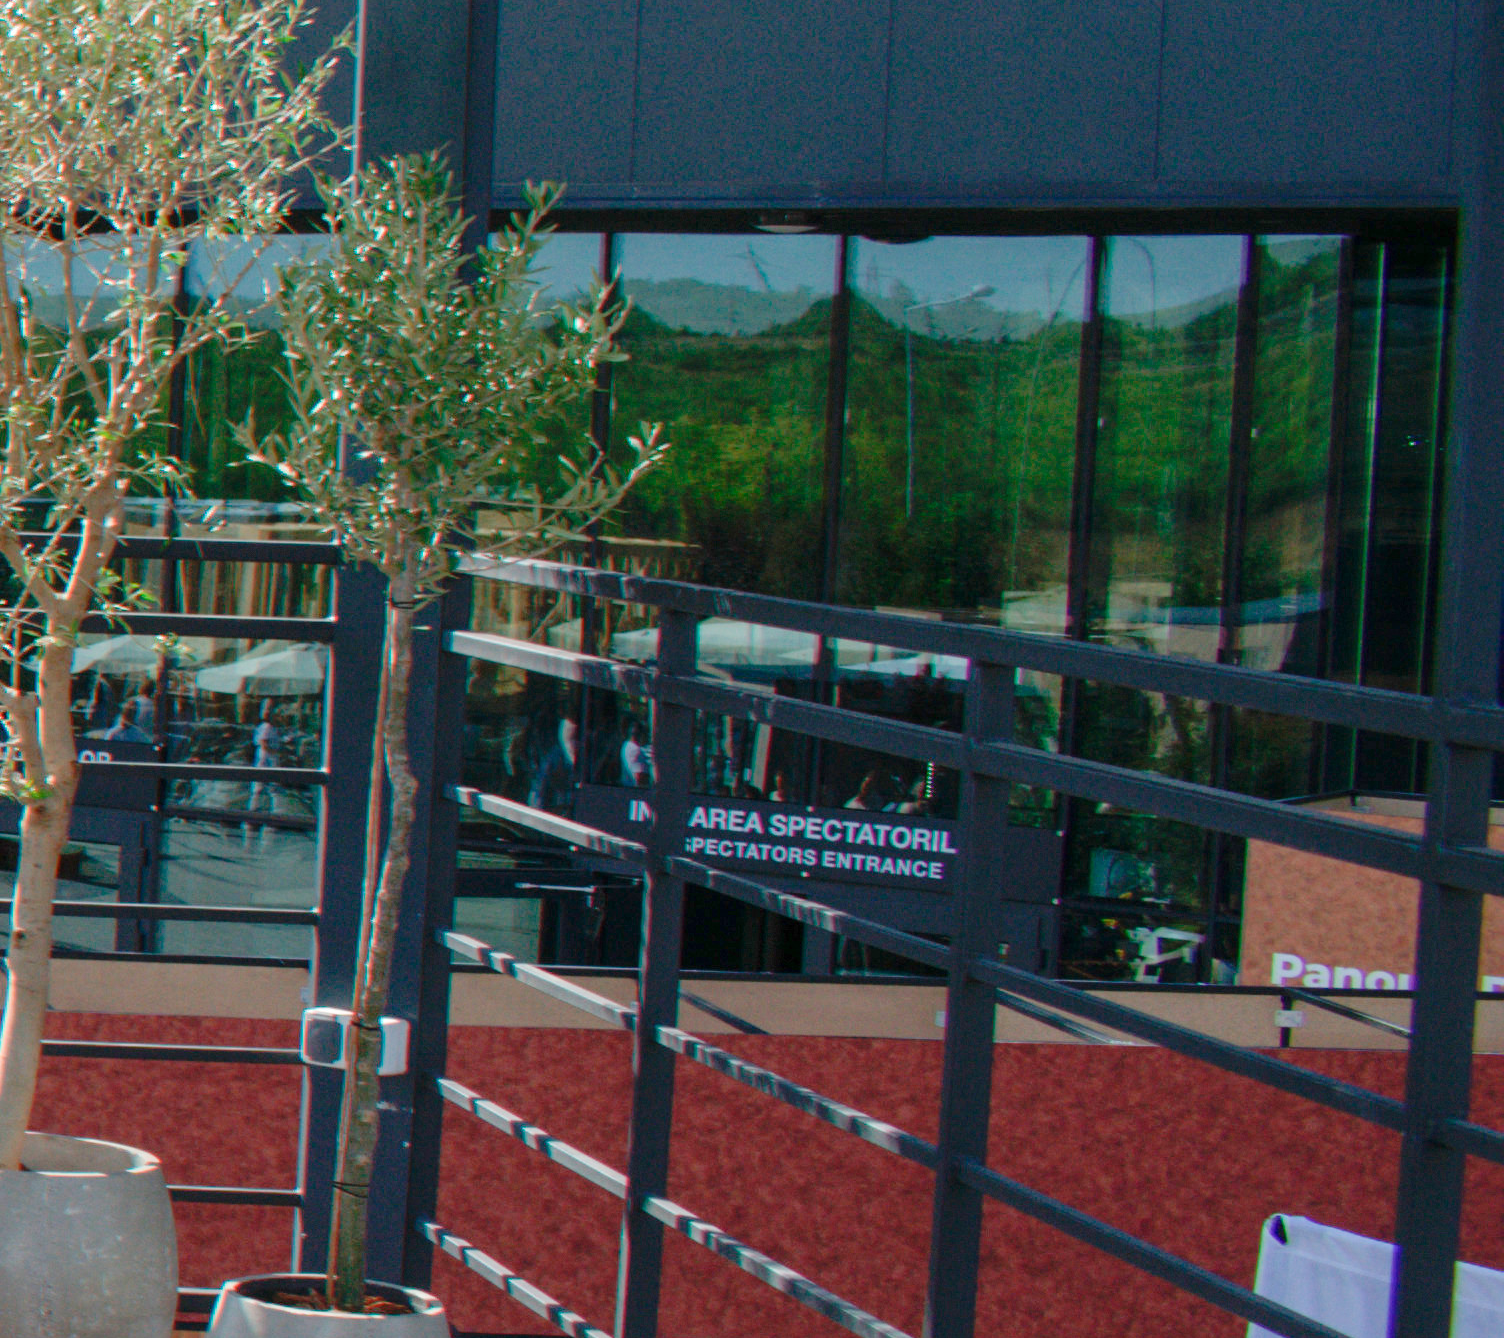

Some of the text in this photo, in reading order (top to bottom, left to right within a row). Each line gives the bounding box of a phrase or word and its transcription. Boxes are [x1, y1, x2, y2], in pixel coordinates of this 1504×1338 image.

[628, 799, 957, 854] INAREA SPECTATORIL
[821, 850, 944, 880] ENTRANCE
